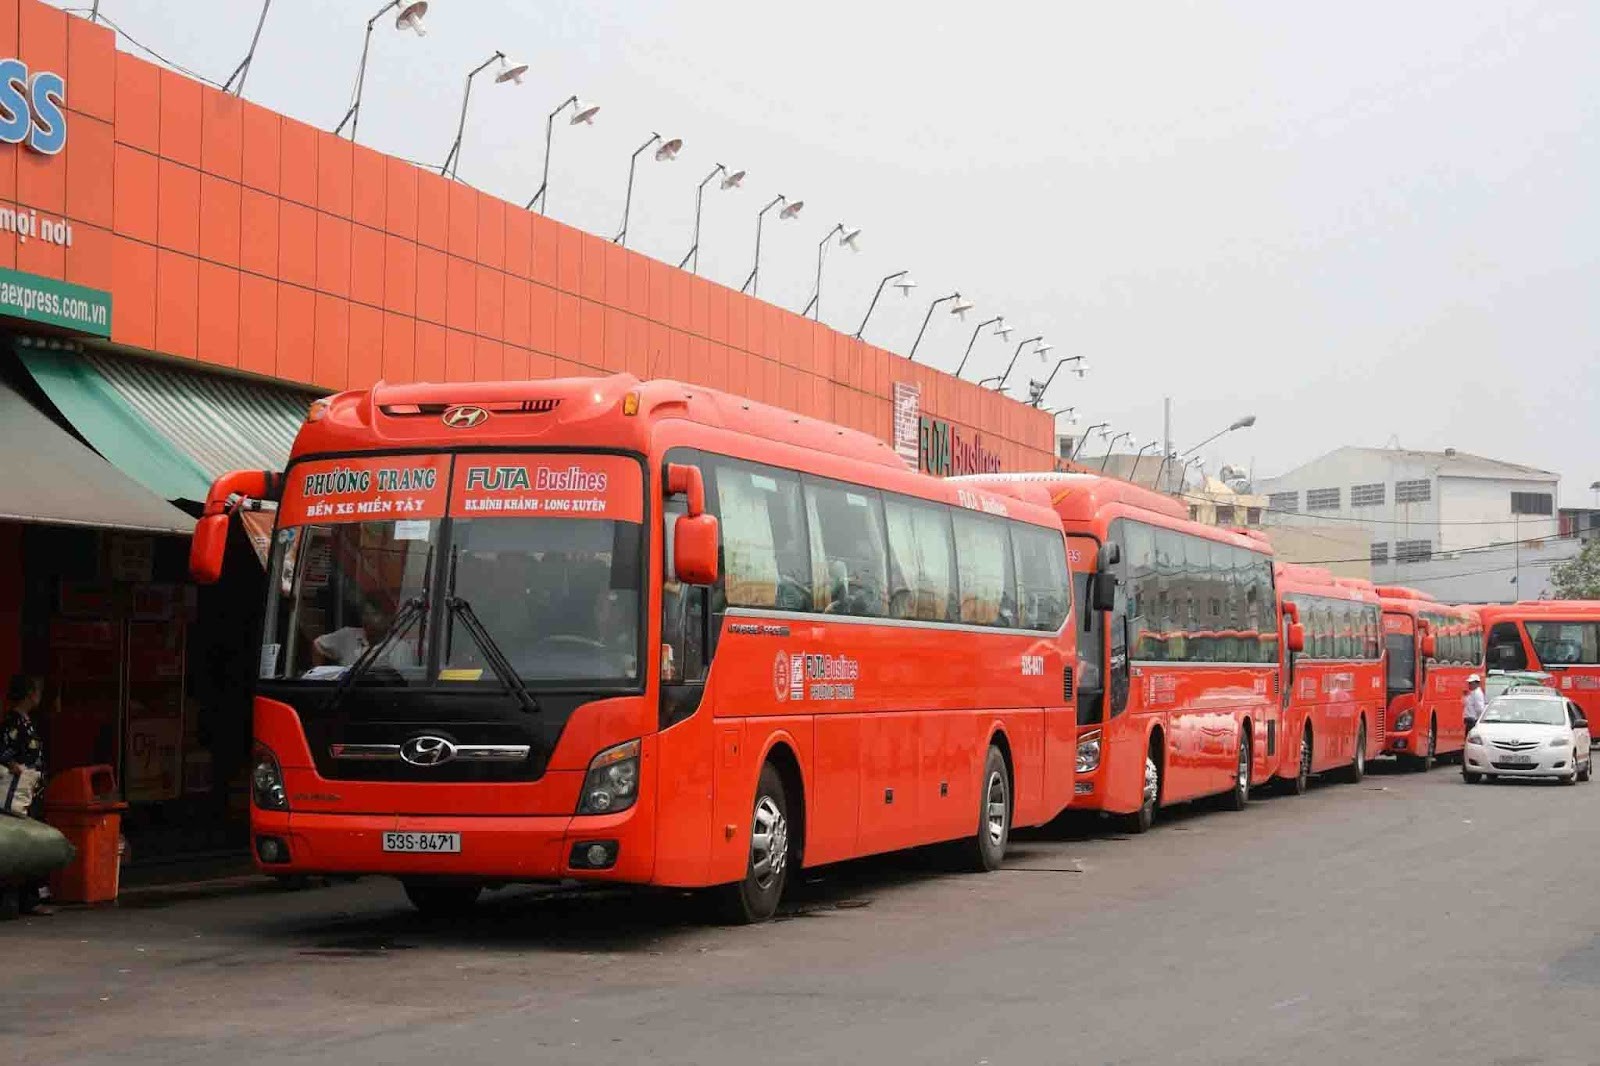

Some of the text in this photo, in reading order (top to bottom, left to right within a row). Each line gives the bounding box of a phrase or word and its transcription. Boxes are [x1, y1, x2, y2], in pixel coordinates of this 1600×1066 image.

[0, 281, 106, 325] aexpress.com.vn
[919, 414, 950, 478] FUTA
[377, 468, 437, 493] TRANG
[465, 466, 607, 493] FUTA Buslines
[336, 502, 355, 515] XE
[395, 497, 425, 512] TÂY
[544, 500, 570, 510] LONG
[386, 833, 454, 850] 53S-8471
